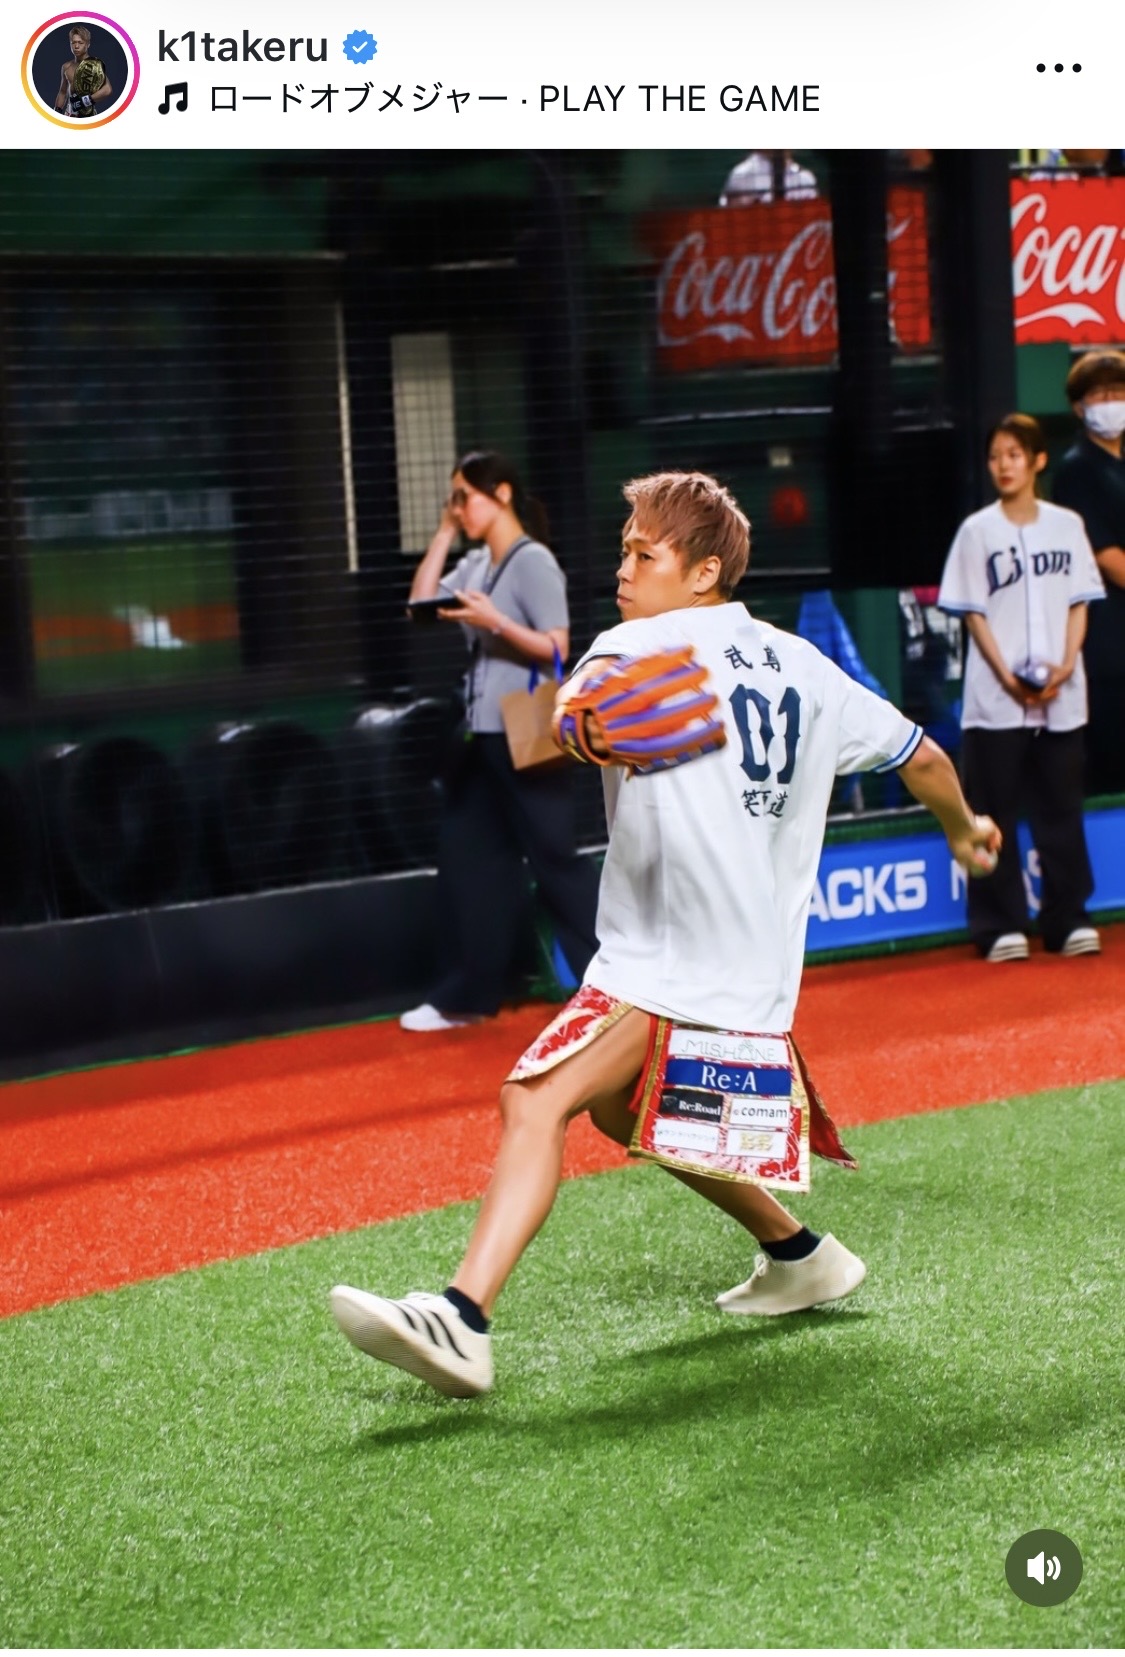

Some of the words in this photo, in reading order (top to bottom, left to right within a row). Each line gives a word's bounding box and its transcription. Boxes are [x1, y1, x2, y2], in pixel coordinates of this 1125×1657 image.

[657, 215, 839, 347] Coca-Co
[728, 683, 801, 785] 01
[701, 1064, 757, 1093] Re:A
